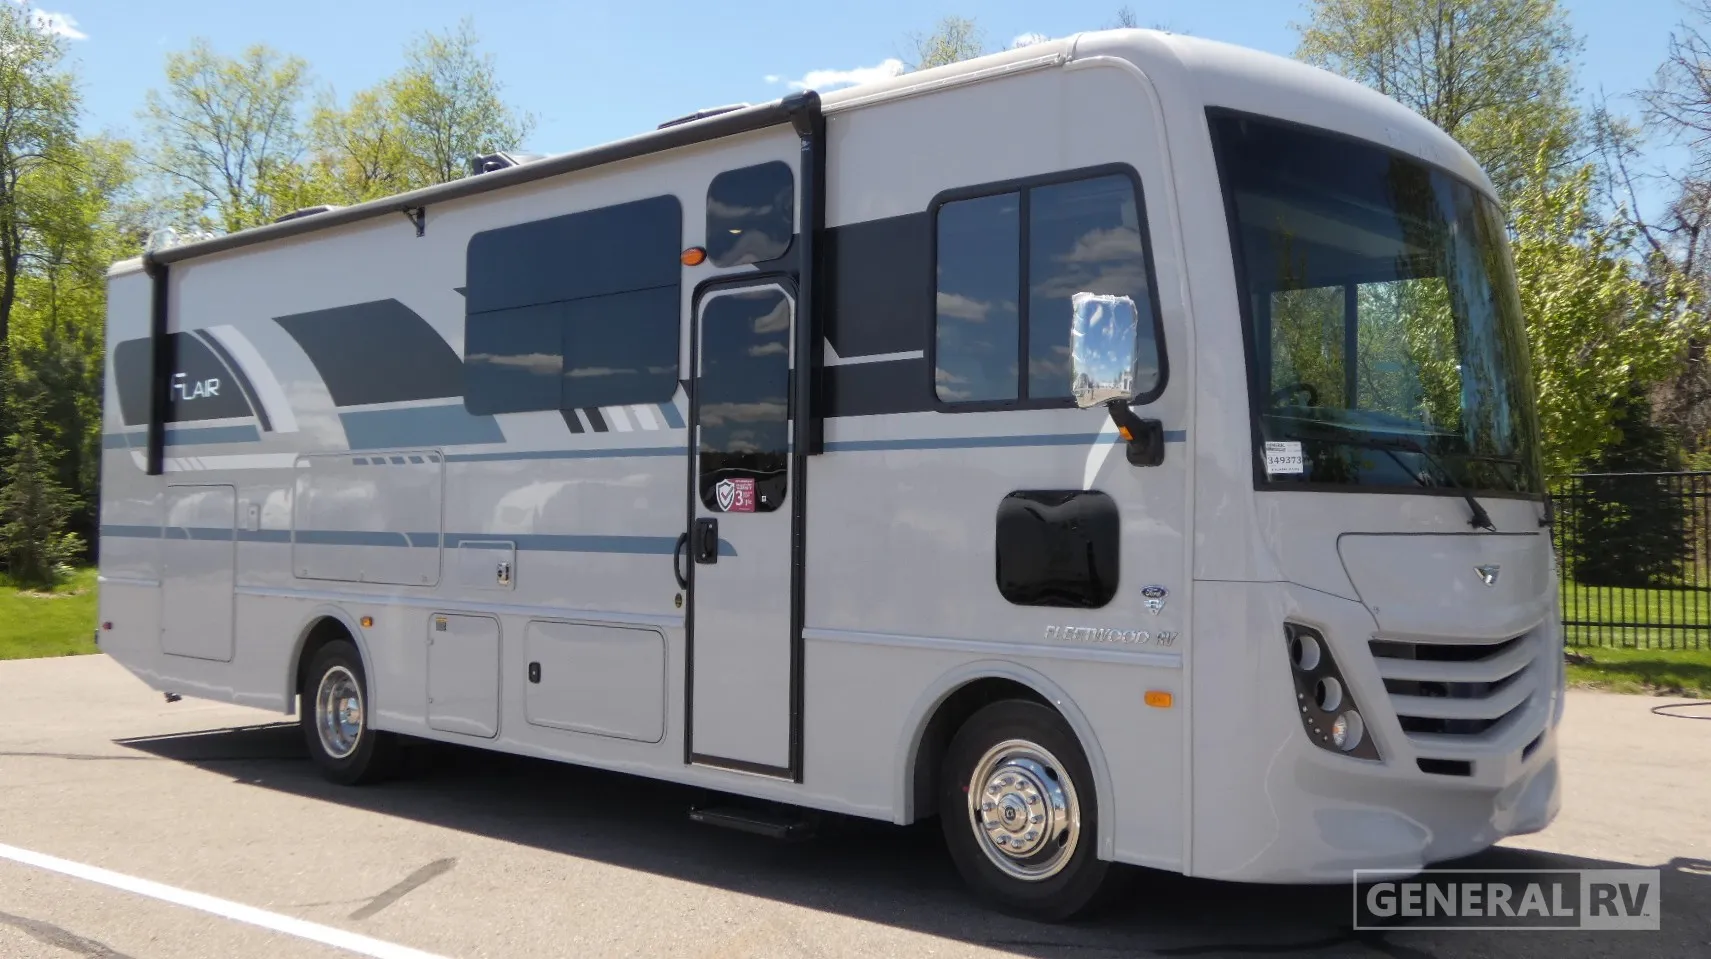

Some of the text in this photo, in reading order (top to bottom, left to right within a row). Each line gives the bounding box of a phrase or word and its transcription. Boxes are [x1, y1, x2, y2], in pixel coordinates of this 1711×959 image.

[170, 372, 220, 402] FLAIR
[1267, 456, 1302, 464] 349373
[735, 490, 744, 506] 3
[1145, 587, 1163, 598] Ford
[1044, 625, 1179, 646] FLEETWOOD RV
